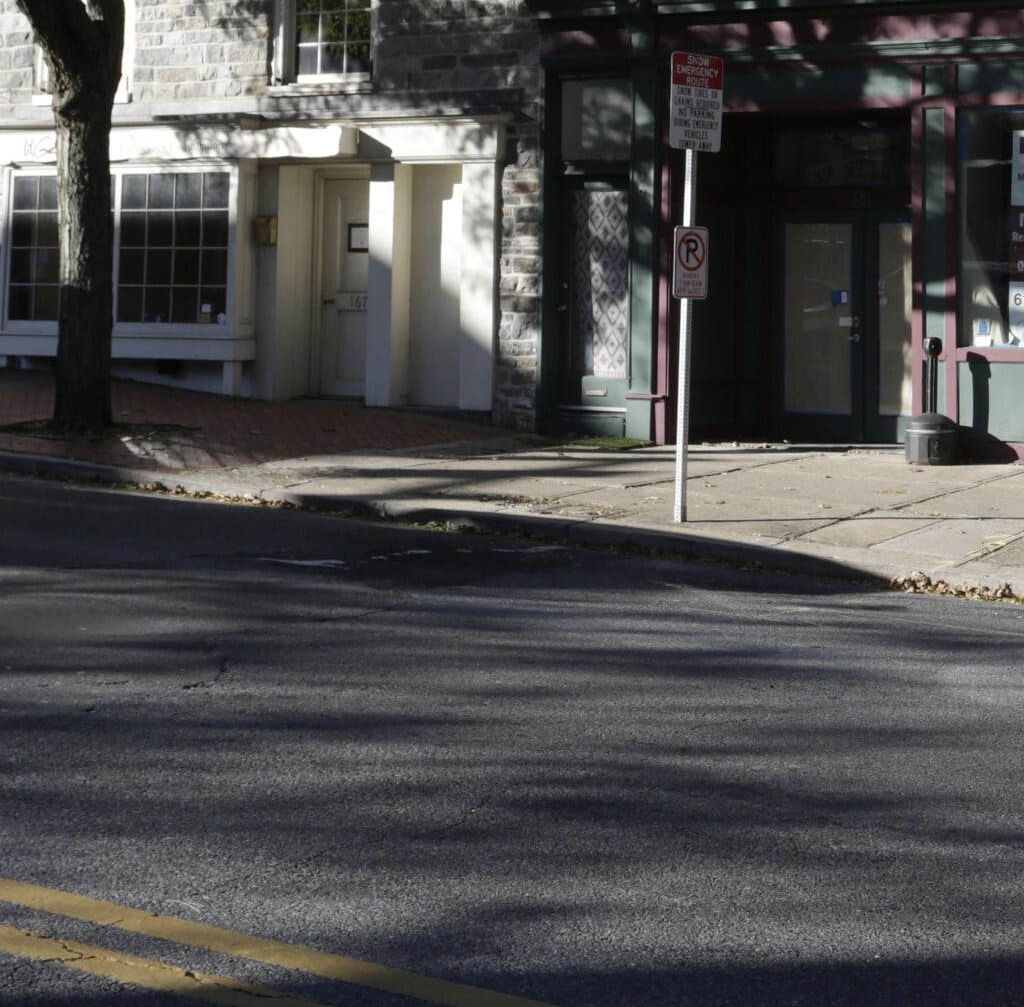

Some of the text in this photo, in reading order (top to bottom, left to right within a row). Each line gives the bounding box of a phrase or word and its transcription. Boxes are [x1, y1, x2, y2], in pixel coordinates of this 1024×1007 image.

[687, 55, 710, 66] SNOW
[676, 65, 719, 78] EMERGENCY
[686, 77, 710, 88] ROUTE
